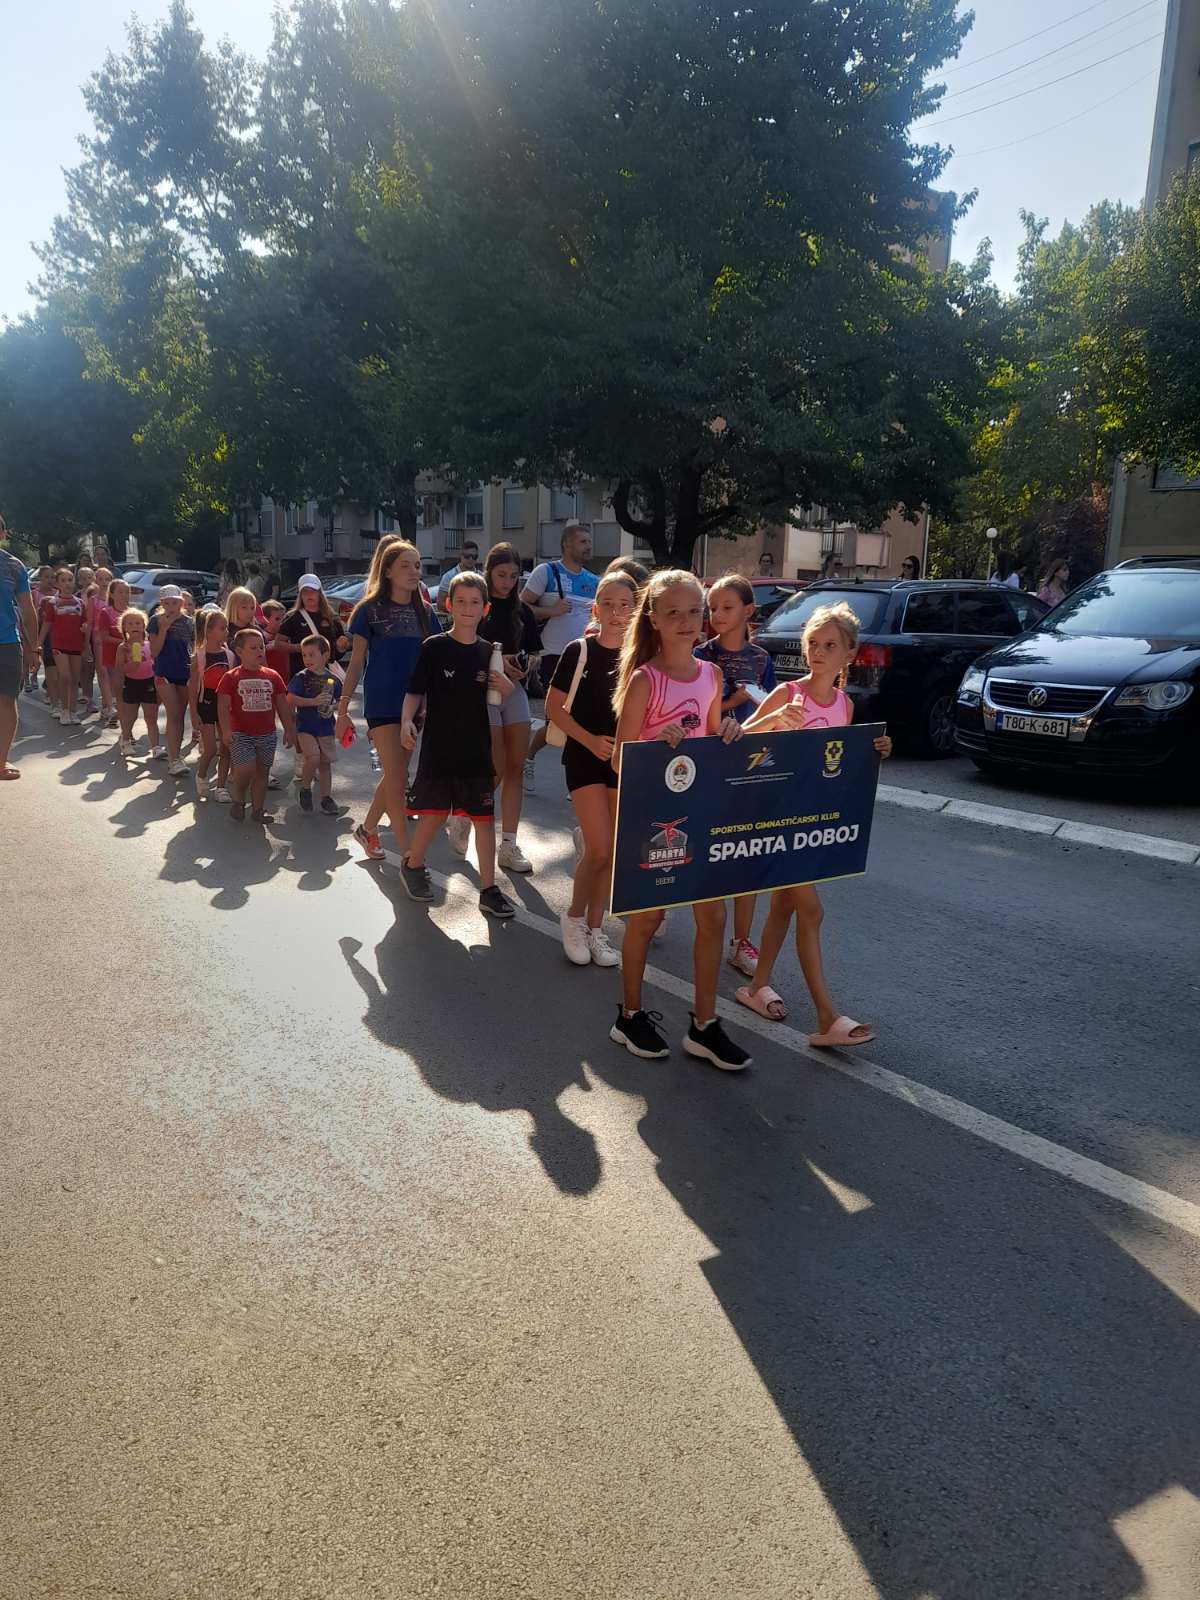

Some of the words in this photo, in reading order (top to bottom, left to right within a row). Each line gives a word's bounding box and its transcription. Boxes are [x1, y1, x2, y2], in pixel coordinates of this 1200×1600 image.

[1004, 715, 1065, 735] T80-K-681
[710, 823, 753, 835] SPORTSKO
[755, 814, 819, 830] GIMNASTIČARSKI
[820, 811, 840, 821] KLUB
[649, 848, 684, 860] SPARTA
[708, 835, 787, 863] SPARTA
[793, 824, 860, 850] DOBOJ
